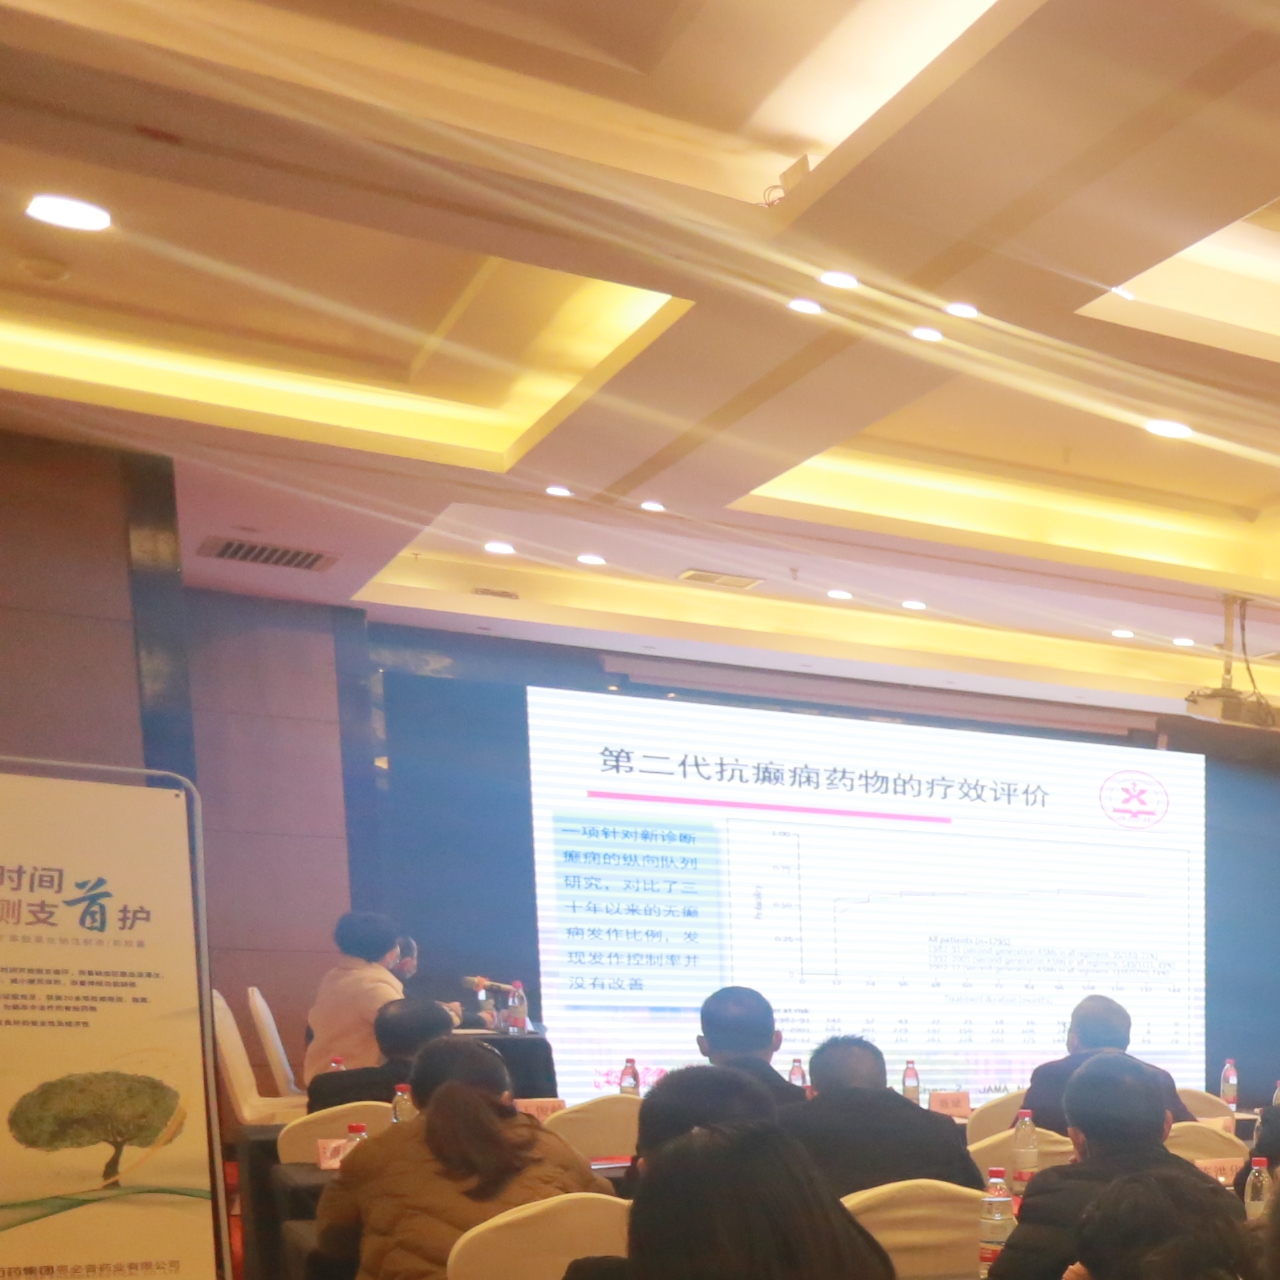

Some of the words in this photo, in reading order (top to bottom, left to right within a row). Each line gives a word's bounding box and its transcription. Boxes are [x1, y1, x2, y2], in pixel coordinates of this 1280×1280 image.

[599, 746, 1050, 808] 第二代抗癫痫药物的疗效评价
[562, 826, 696, 844] 一项针对新诊断
[563, 850, 698, 870] 癫痫的纵向队列
[565, 901, 699, 918] 十年以来的无癫
[567, 951, 699, 967] 现发作控制率并
[569, 976, 644, 991] 没有改善
[978, 1083, 1009, 1094] JAMA
